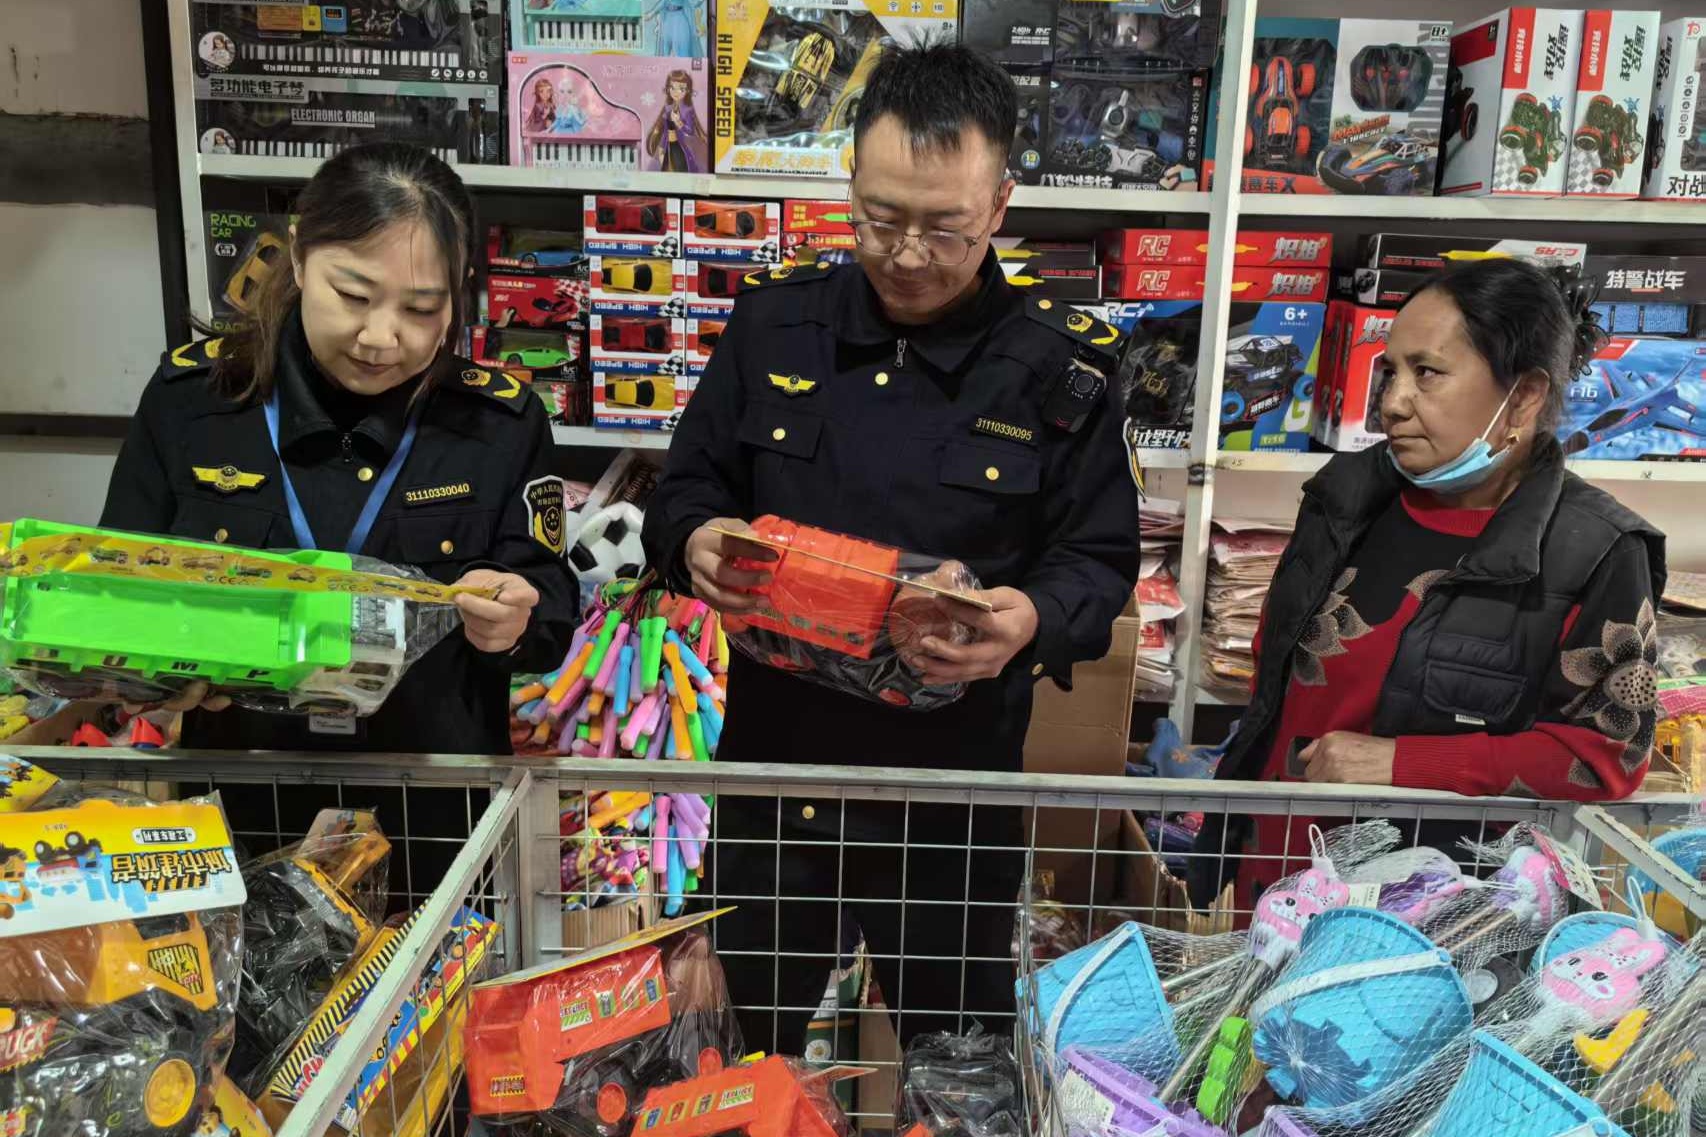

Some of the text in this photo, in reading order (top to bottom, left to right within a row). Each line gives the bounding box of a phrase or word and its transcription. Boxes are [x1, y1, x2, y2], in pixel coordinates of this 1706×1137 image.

[210, 78, 304, 95] 多功能电子琴
[715, 34, 732, 137] HIGH SPEED
[291, 108, 376, 123] ELECTRONIC ORGAN
[210, 214, 256, 227] RACING
[211, 227, 232, 238] CAR
[1137, 235, 1171, 256] RC
[1136, 271, 1170, 291] RC
[1604, 269, 1687, 290] 特警战车
[1284, 306, 1308, 320] 6+
[974, 417, 1033, 442] 31110330095
[405, 483, 470, 502] 31110330040
[111, 848, 232, 882] 城市建筑者
